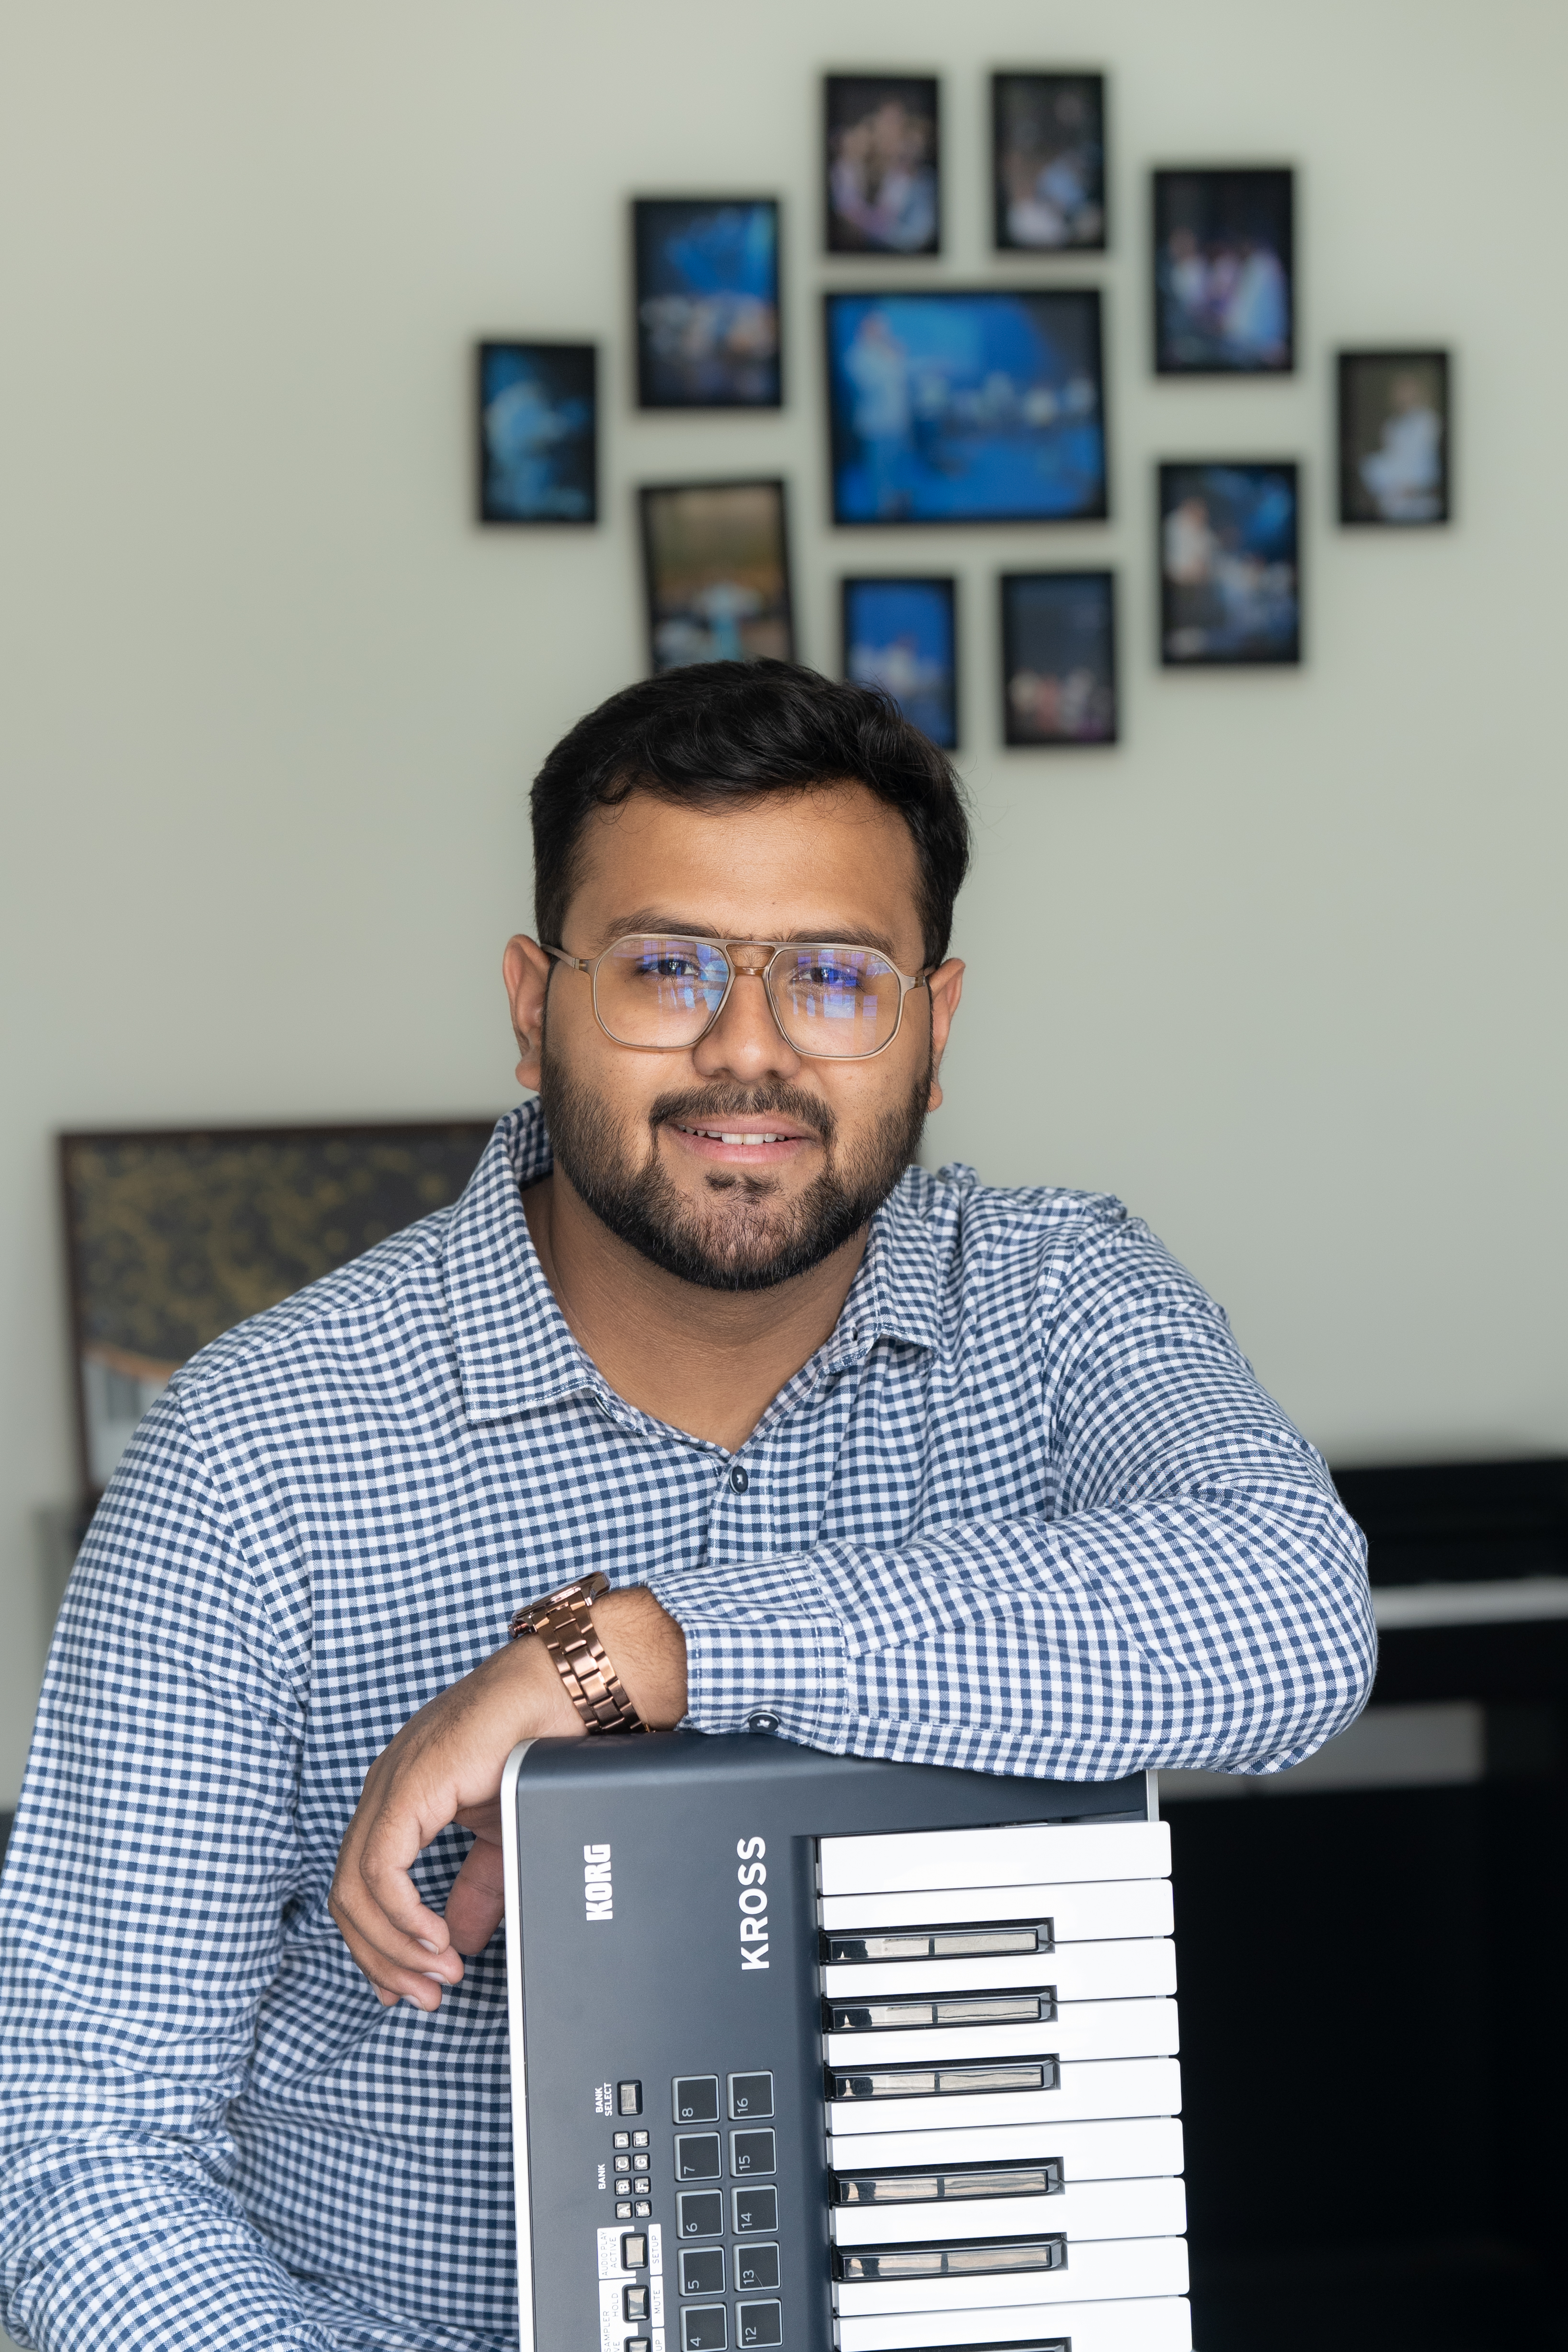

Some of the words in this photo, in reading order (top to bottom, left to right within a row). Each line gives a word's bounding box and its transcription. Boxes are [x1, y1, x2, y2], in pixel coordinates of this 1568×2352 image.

[584, 1844, 613, 1921] KORG
[737, 1836, 769, 1970] KROSS
[604, 2082, 612, 2116] SELECT
[737, 2098, 748, 2113] 16
[682, 2108, 693, 2117] 8
[618, 2137, 627, 2146] D
[618, 2160, 628, 2169] C
[637, 2158, 647, 2168] G
[739, 2155, 750, 2170] 15
[684, 2166, 695, 2174] 7
[598, 2164, 606, 2190] BANK
[618, 2183, 629, 2192] B
[619, 2206, 630, 2216] A
[639, 2205, 648, 2214] E
[741, 2212, 752, 2228] 14
[686, 2223, 698, 2232] 6
[743, 2270, 755, 2284] 13
[688, 2280, 699, 2289] 5
[745, 2327, 757, 2342] 12
[690, 2337, 701, 2347] 4
